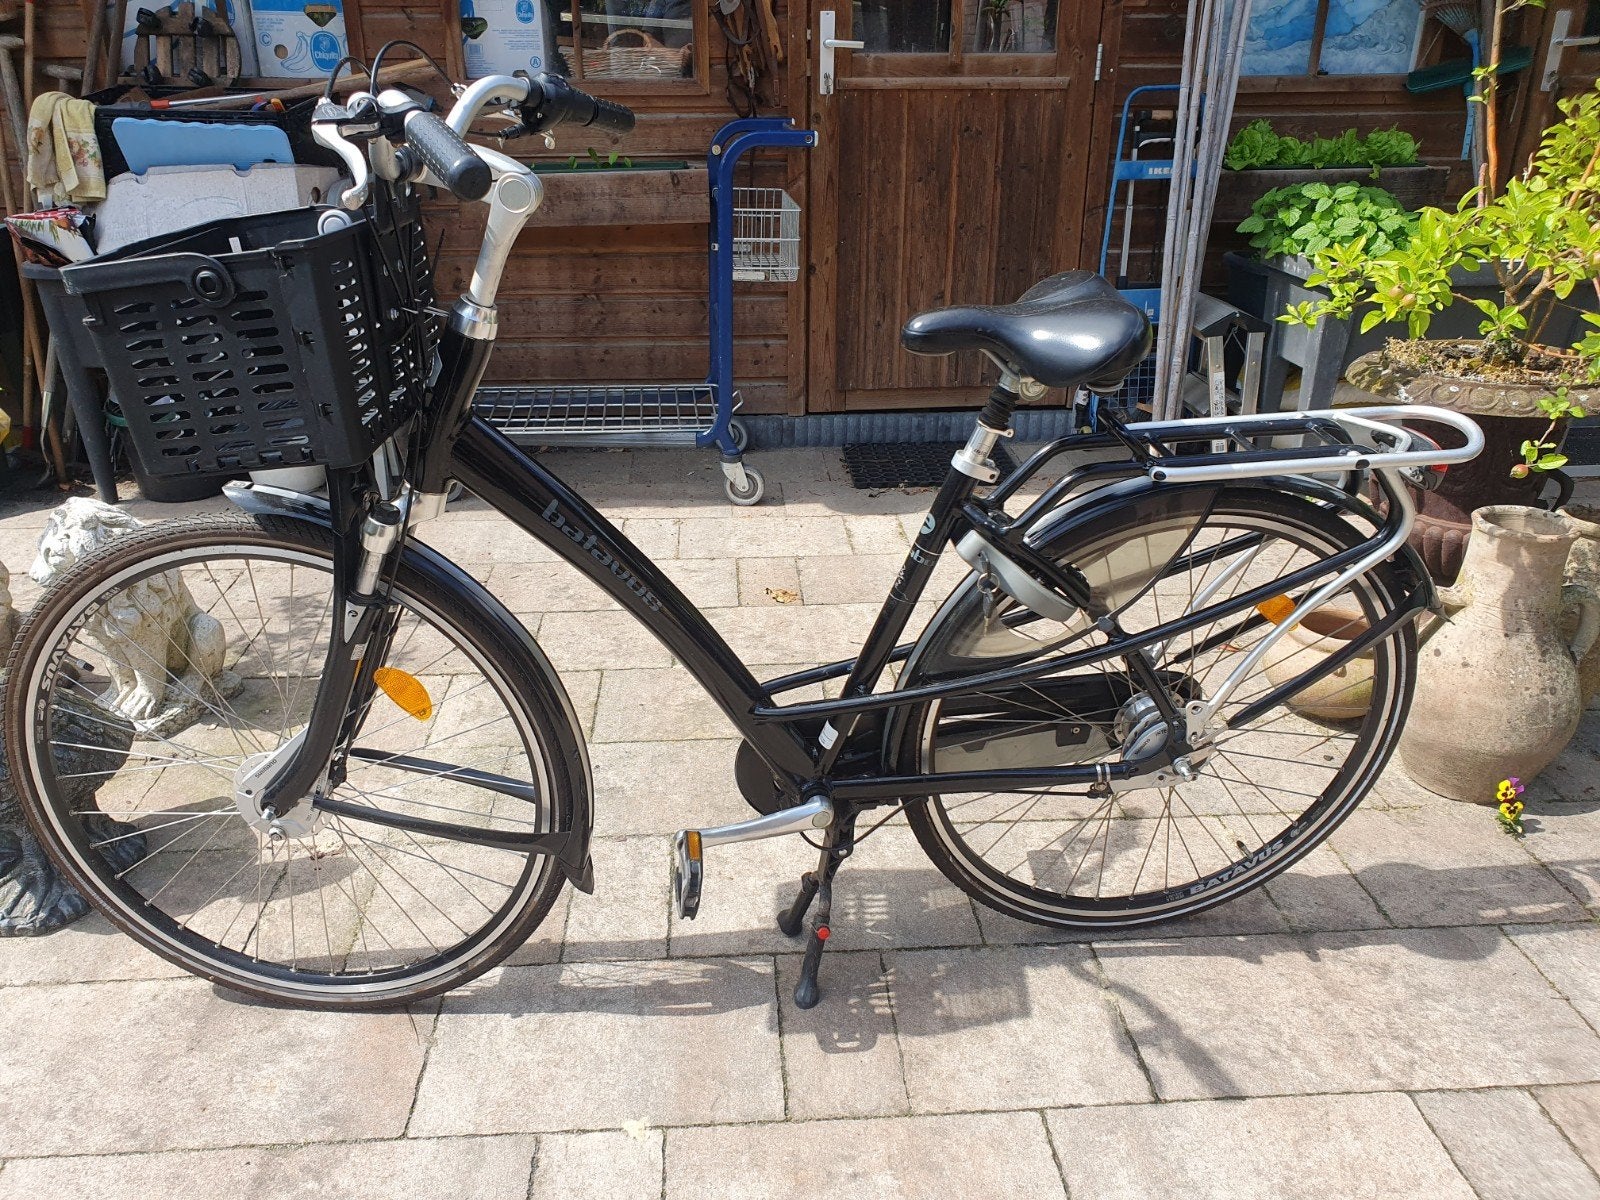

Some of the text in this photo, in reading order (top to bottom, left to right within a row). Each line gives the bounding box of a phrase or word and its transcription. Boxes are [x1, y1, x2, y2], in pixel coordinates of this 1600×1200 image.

[1148, 167, 1174, 175] IKE
[542, 498, 664, 613] batavus
[40, 601, 100, 692] BATAVUS
[1189, 838, 1286, 895] BATAVUS
